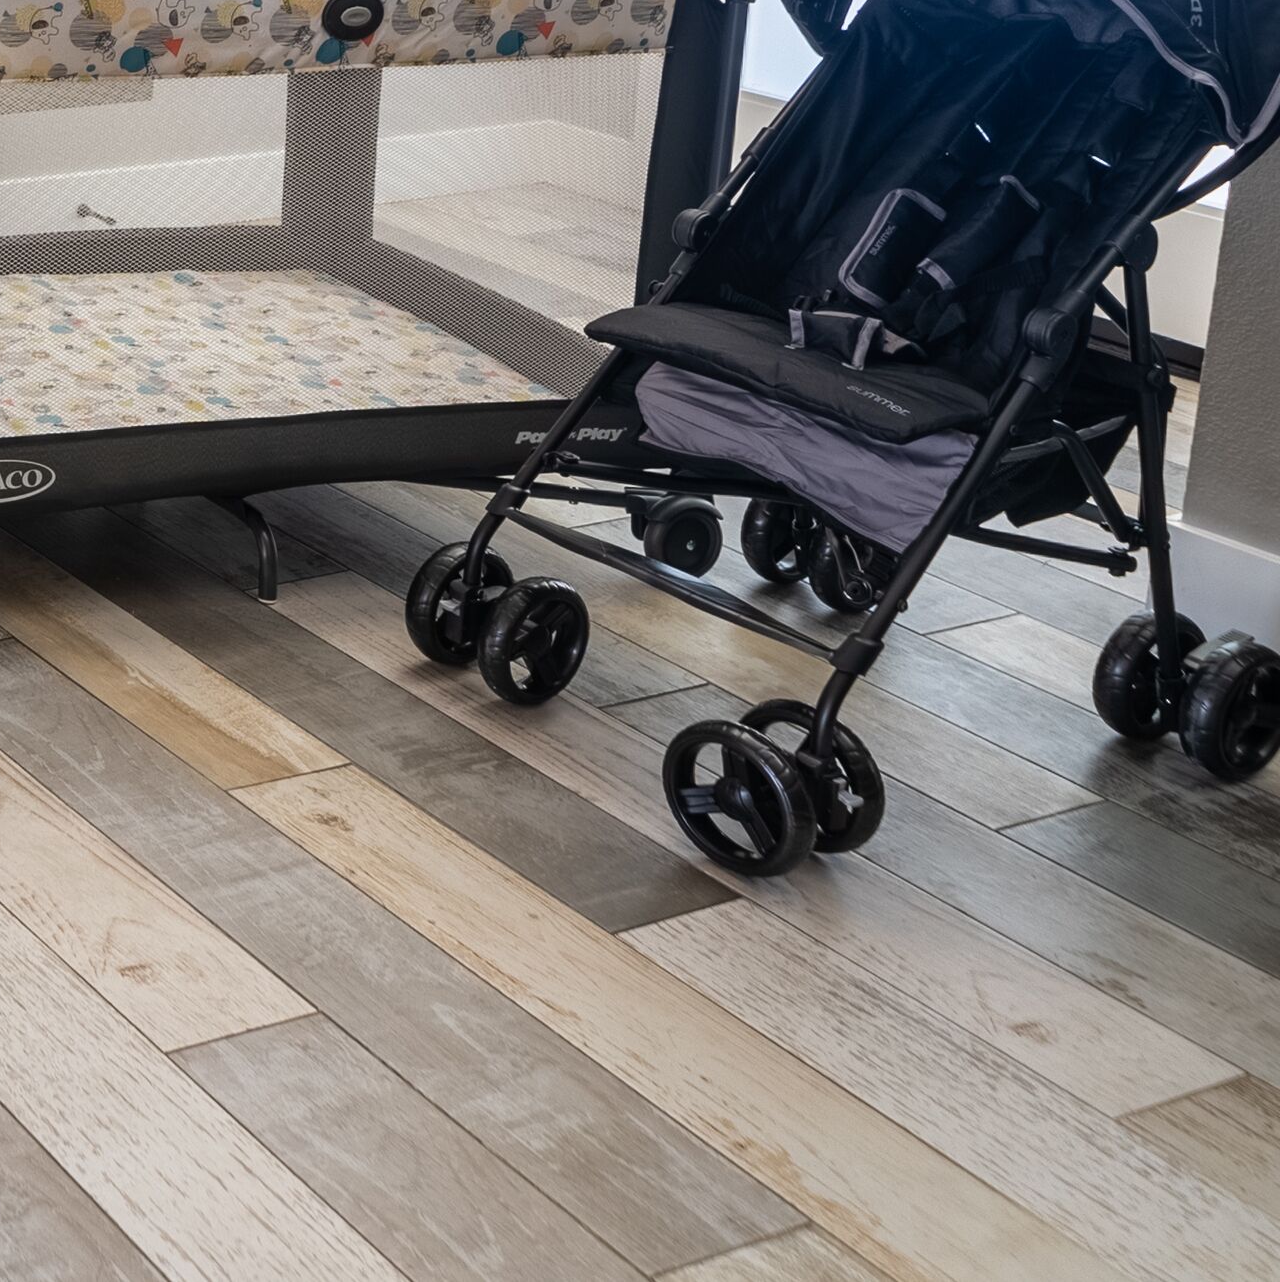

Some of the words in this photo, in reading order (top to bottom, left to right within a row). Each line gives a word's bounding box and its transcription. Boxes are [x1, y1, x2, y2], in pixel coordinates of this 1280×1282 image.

[846, 385, 911, 416] summer
[515, 431, 548, 444] Pa
[577, 428, 623, 441] Play
